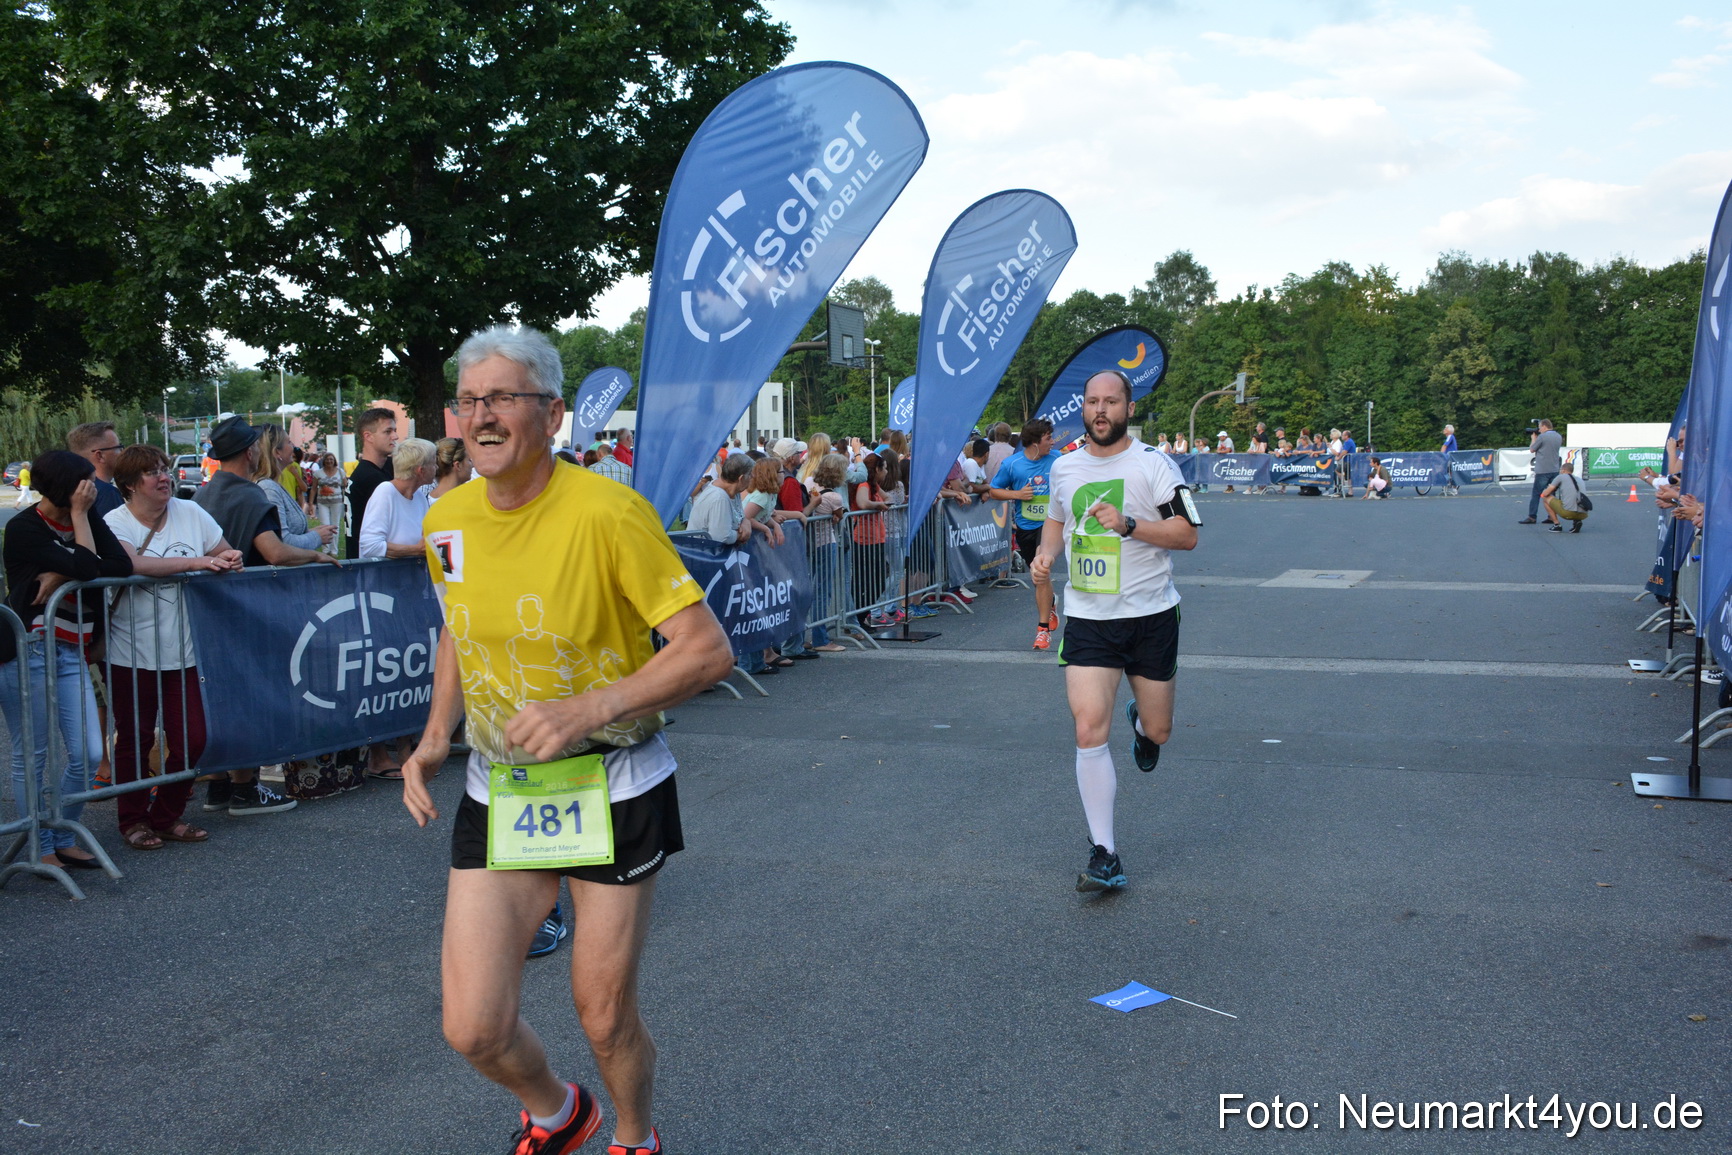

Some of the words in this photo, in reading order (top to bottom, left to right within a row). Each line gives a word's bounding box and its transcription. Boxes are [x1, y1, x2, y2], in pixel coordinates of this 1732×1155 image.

[717, 111, 867, 310] Fischer
[768, 150, 884, 308] AUTOMOBILE
[957, 219, 1042, 353] Fischer
[988, 244, 1053, 351] AUTOMOBILE
[1132, 364, 1159, 385] Medien
[587, 376, 620, 420] Fischer
[1271, 463, 1317, 473] Frischmann
[1452, 461, 1483, 471] Frischmann
[1593, 452, 1620, 466] AOK
[1220, 466, 1257, 476] Fischer
[1027, 505, 1045, 514] 456
[1077, 557, 1106, 577] 100
[724, 576, 793, 617] Fischer
[731, 609, 791, 636] AUTOMOBILE
[545, 781, 568, 791] 2016
[513, 800, 582, 838] 481
[522, 845, 557, 854] Bernhard
[558, 844, 581, 852] Meyer
